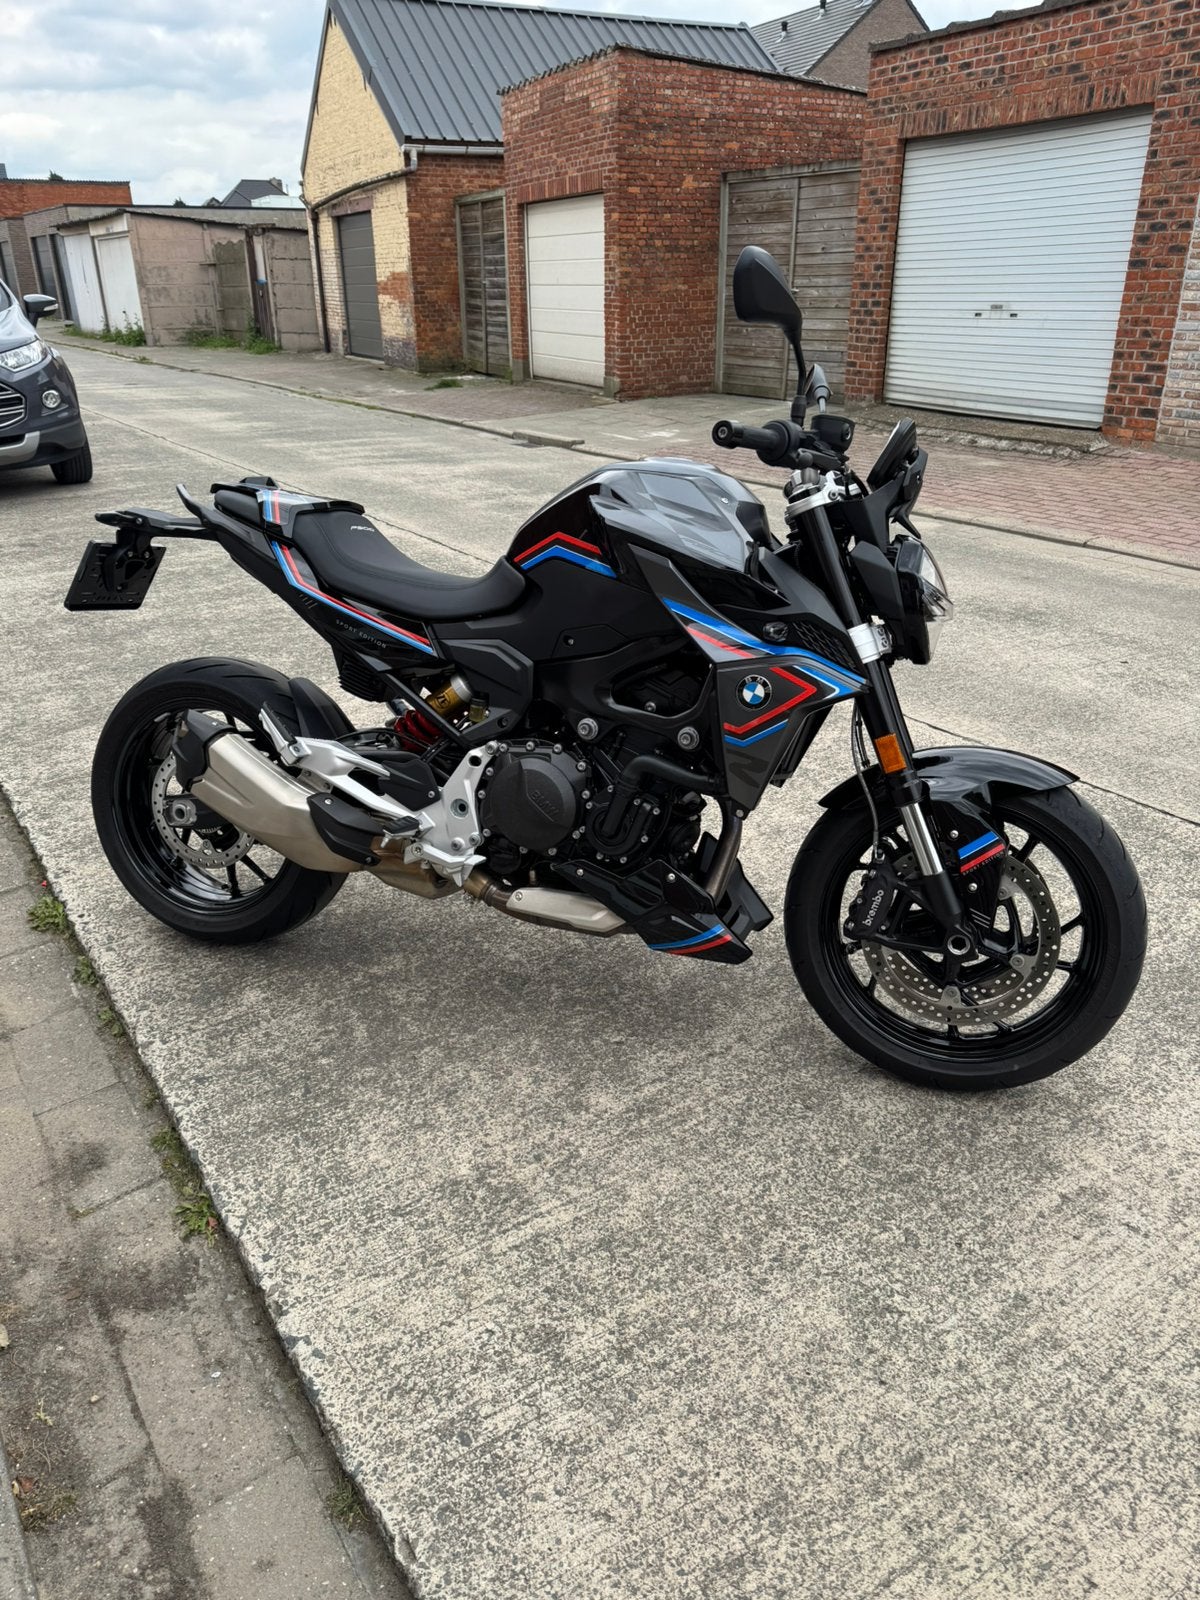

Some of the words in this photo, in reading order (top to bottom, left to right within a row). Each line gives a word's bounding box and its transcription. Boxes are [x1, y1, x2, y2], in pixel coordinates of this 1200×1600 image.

[336, 619, 357, 632] SPORT
[359, 631, 386, 649] EDITION
[530, 790, 560, 818] BMW
[862, 889, 885, 927] brembo
